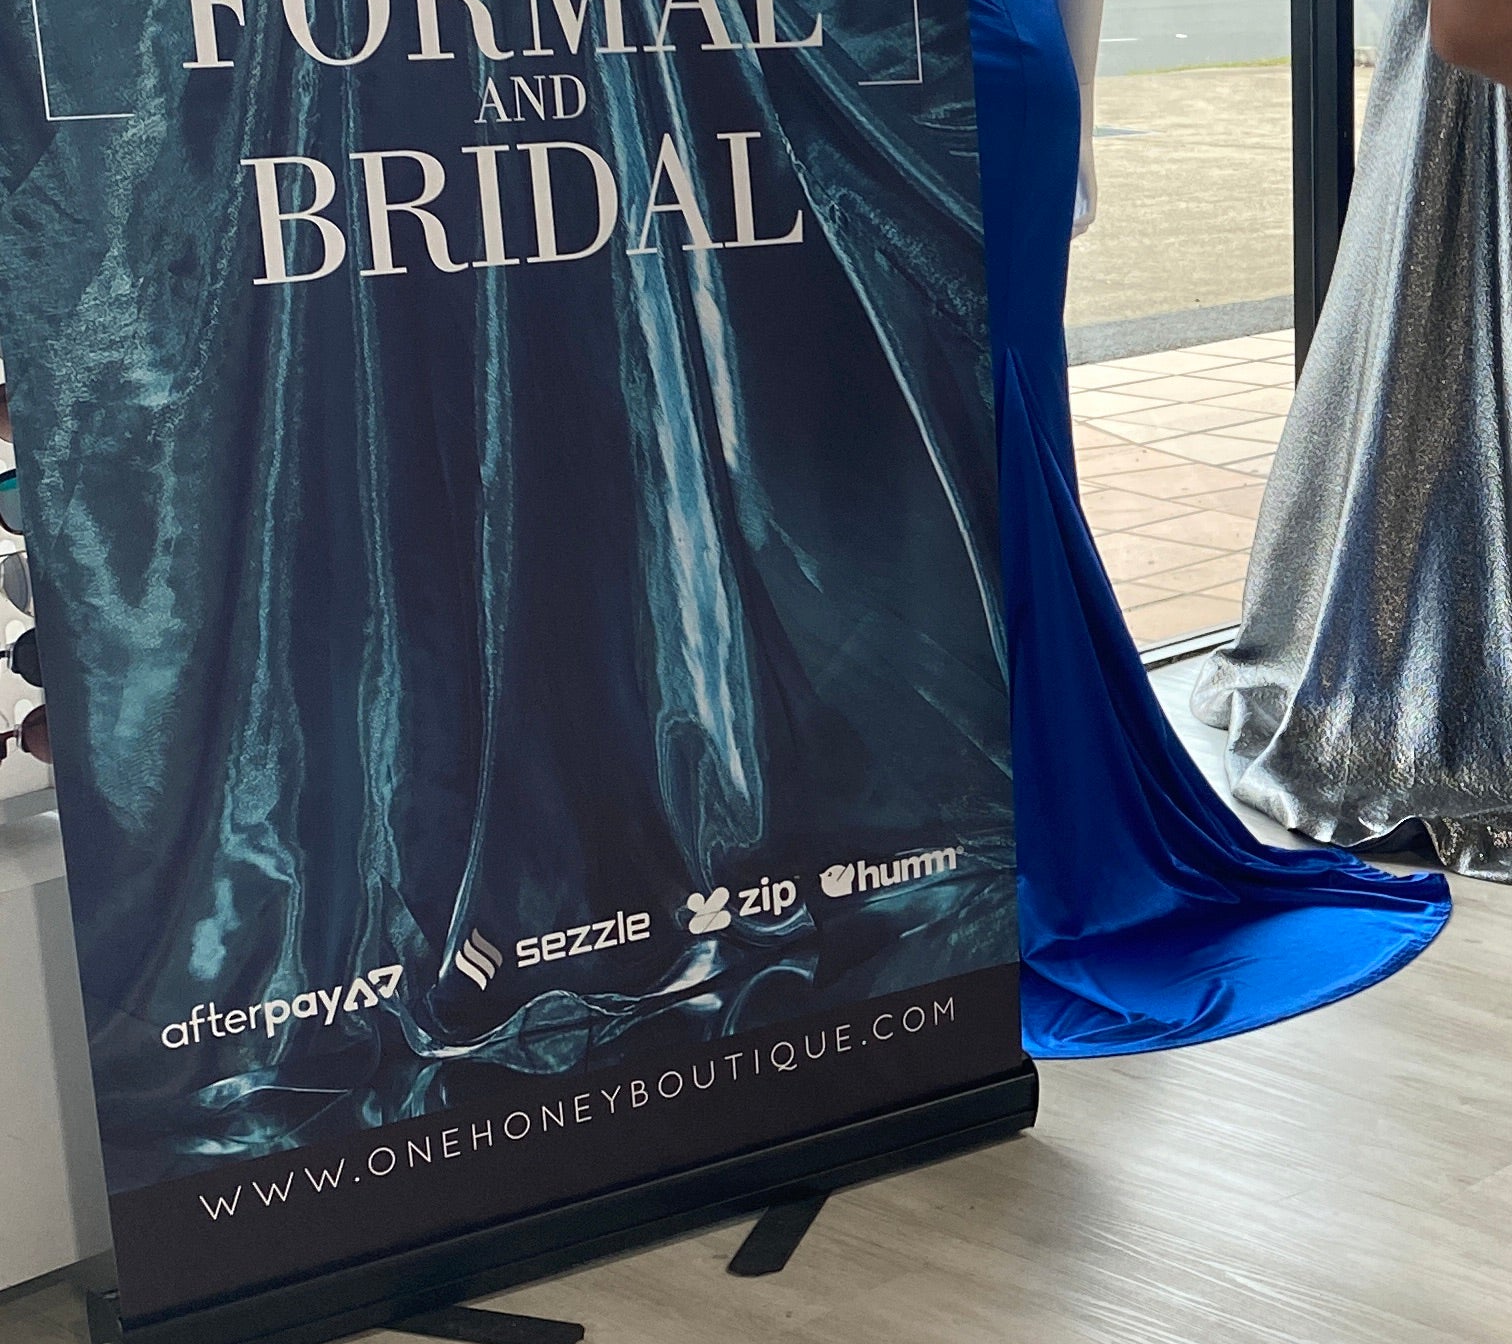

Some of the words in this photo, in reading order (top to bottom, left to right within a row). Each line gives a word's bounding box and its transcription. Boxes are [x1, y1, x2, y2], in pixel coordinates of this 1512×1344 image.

[474, 74, 587, 124] AND
[240, 131, 804, 286] BRIDAL
[738, 876, 797, 916] zip
[515, 908, 652, 969] sezzle
[161, 986, 342, 1049] afterpay
[199, 995, 958, 1222] WWW.ONEHONEYBOUTIQUE.COM
